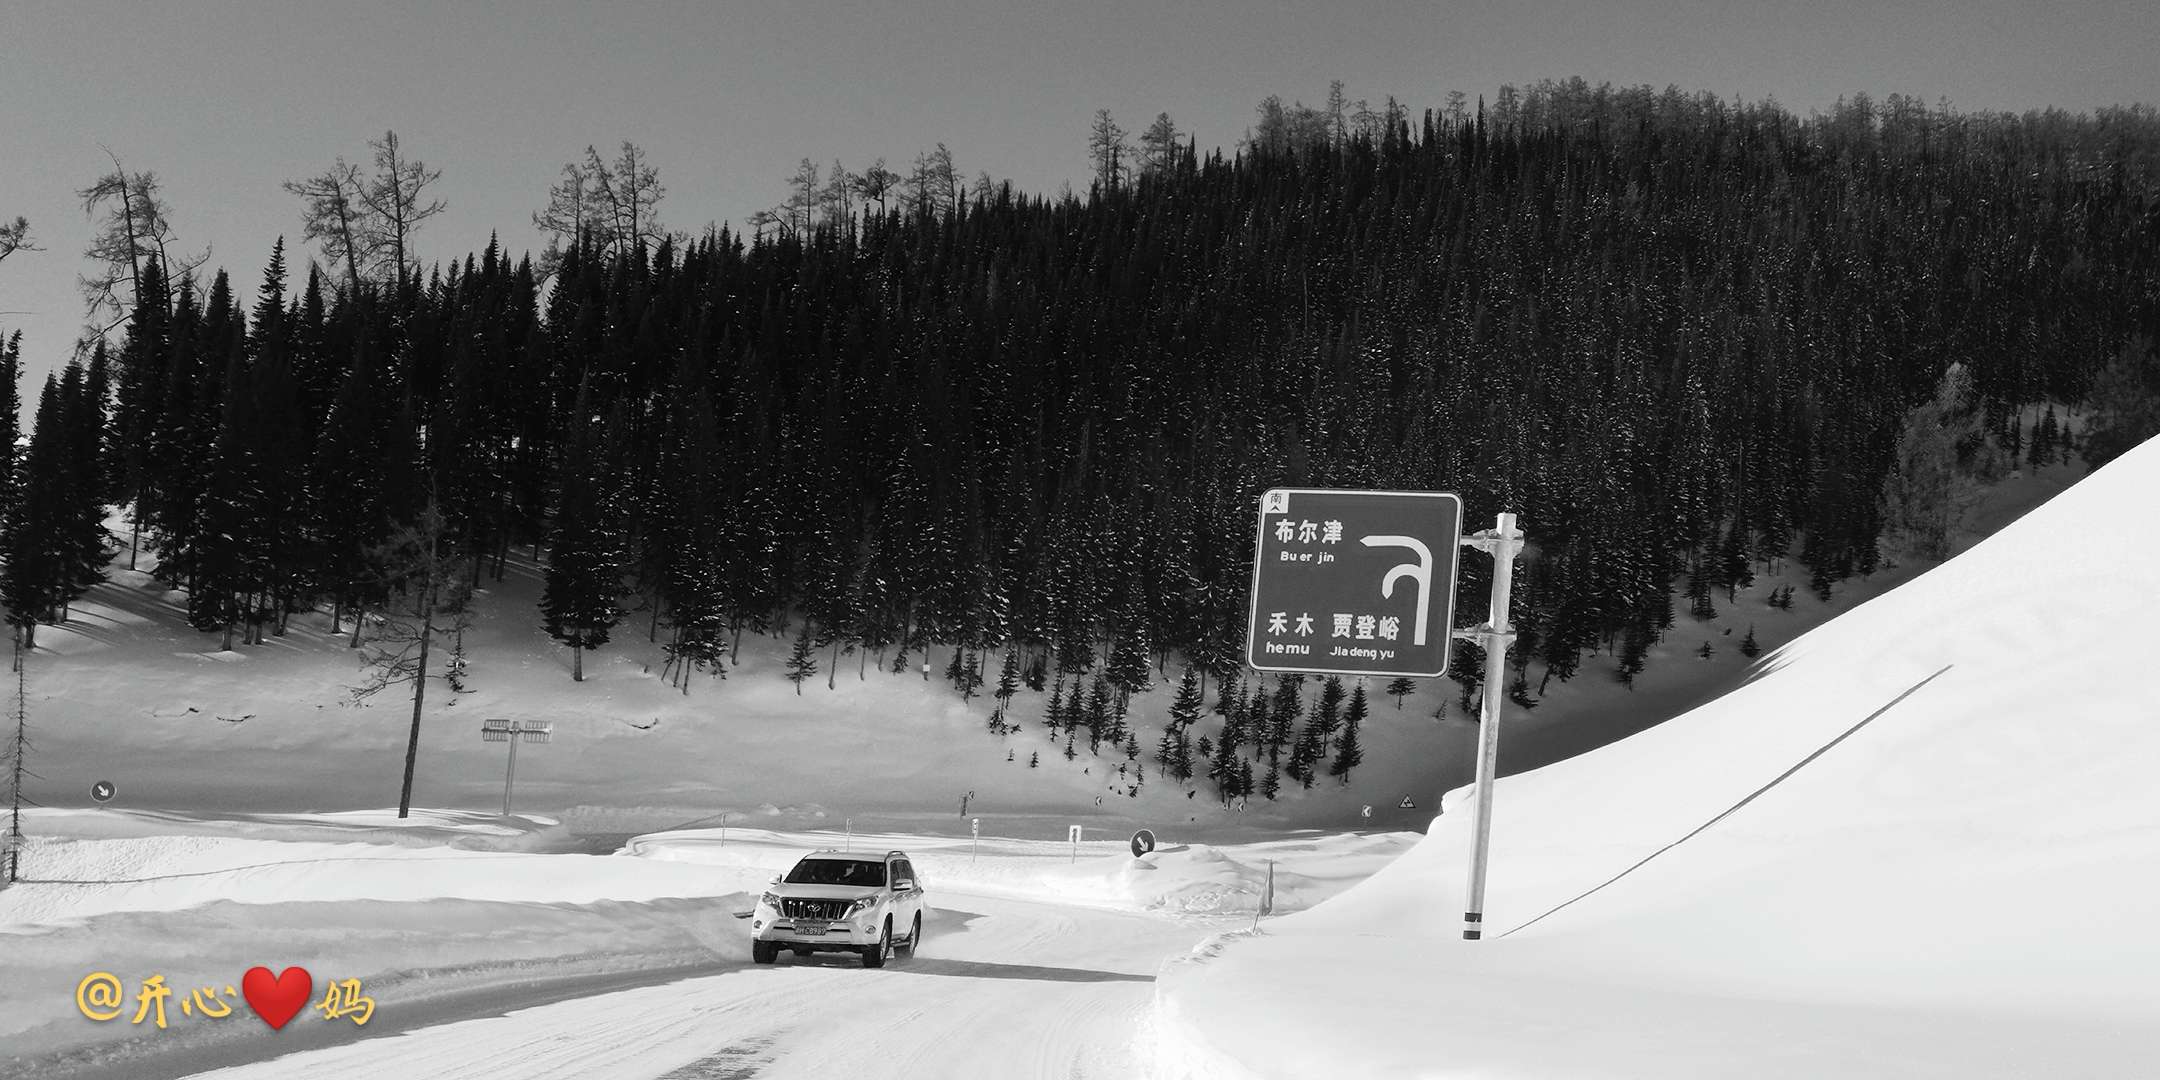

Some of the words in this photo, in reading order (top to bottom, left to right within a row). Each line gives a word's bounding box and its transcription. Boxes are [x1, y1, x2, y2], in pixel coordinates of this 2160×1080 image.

[1274, 518, 1343, 545] 布尔津
[1280, 551, 1297, 561] Bu
[1299, 553, 1313, 562] er
[1317, 551, 1335, 565] jin
[1331, 613, 1400, 641] 贾登峪
